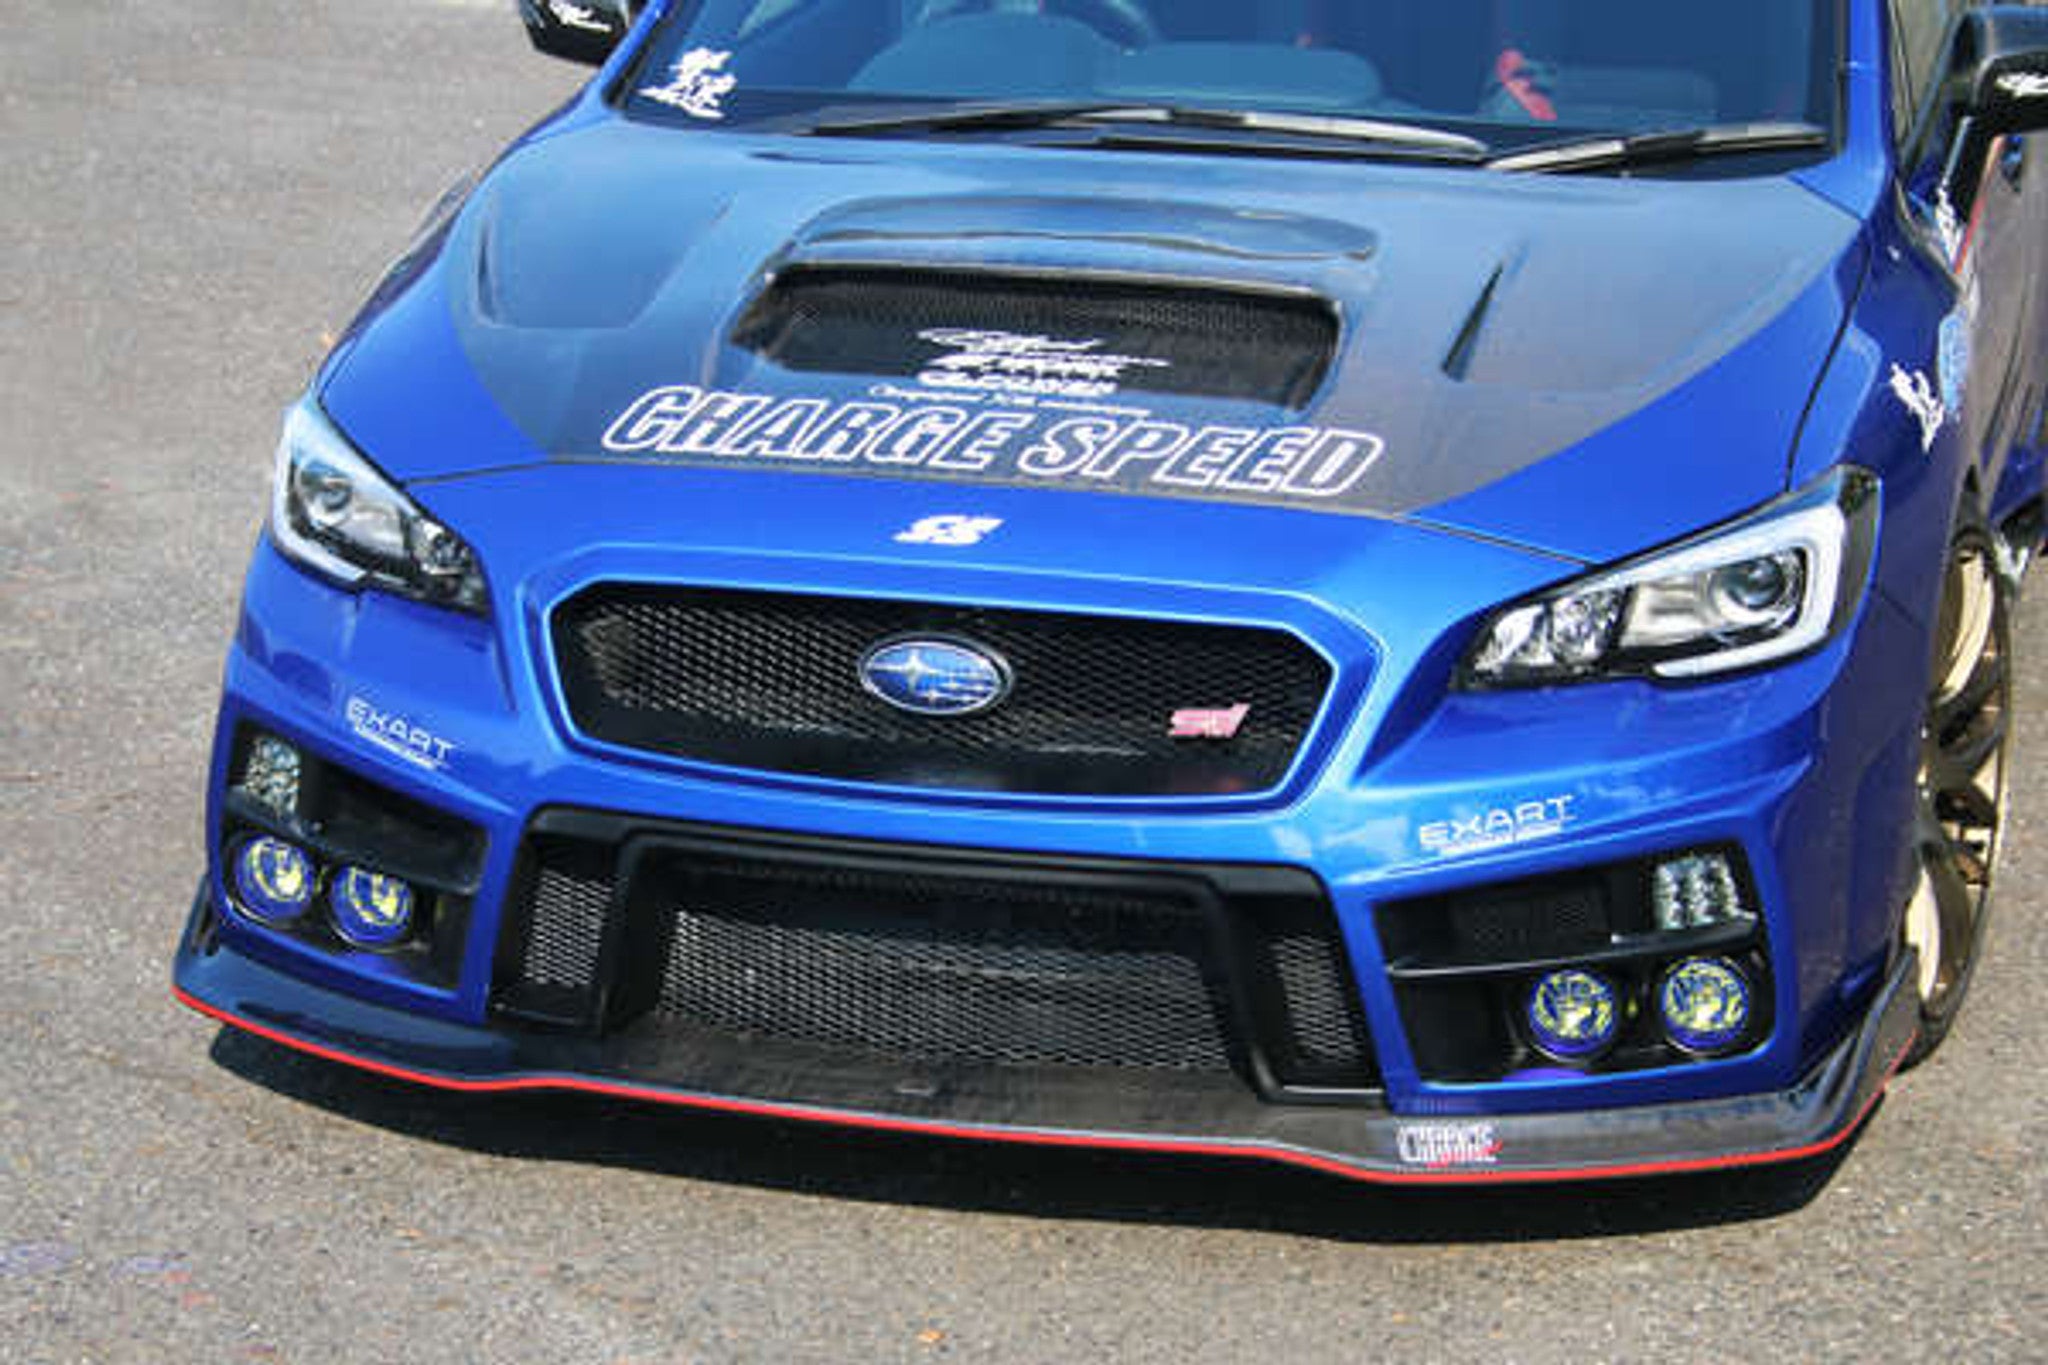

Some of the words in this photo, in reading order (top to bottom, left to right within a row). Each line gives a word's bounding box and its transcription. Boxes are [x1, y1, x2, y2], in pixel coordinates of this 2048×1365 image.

[601, 384, 1029, 472] CHARGE
[1017, 416, 1385, 496] SPEED
[346, 696, 457, 762] EXART
[1419, 795, 1577, 848] EXART
